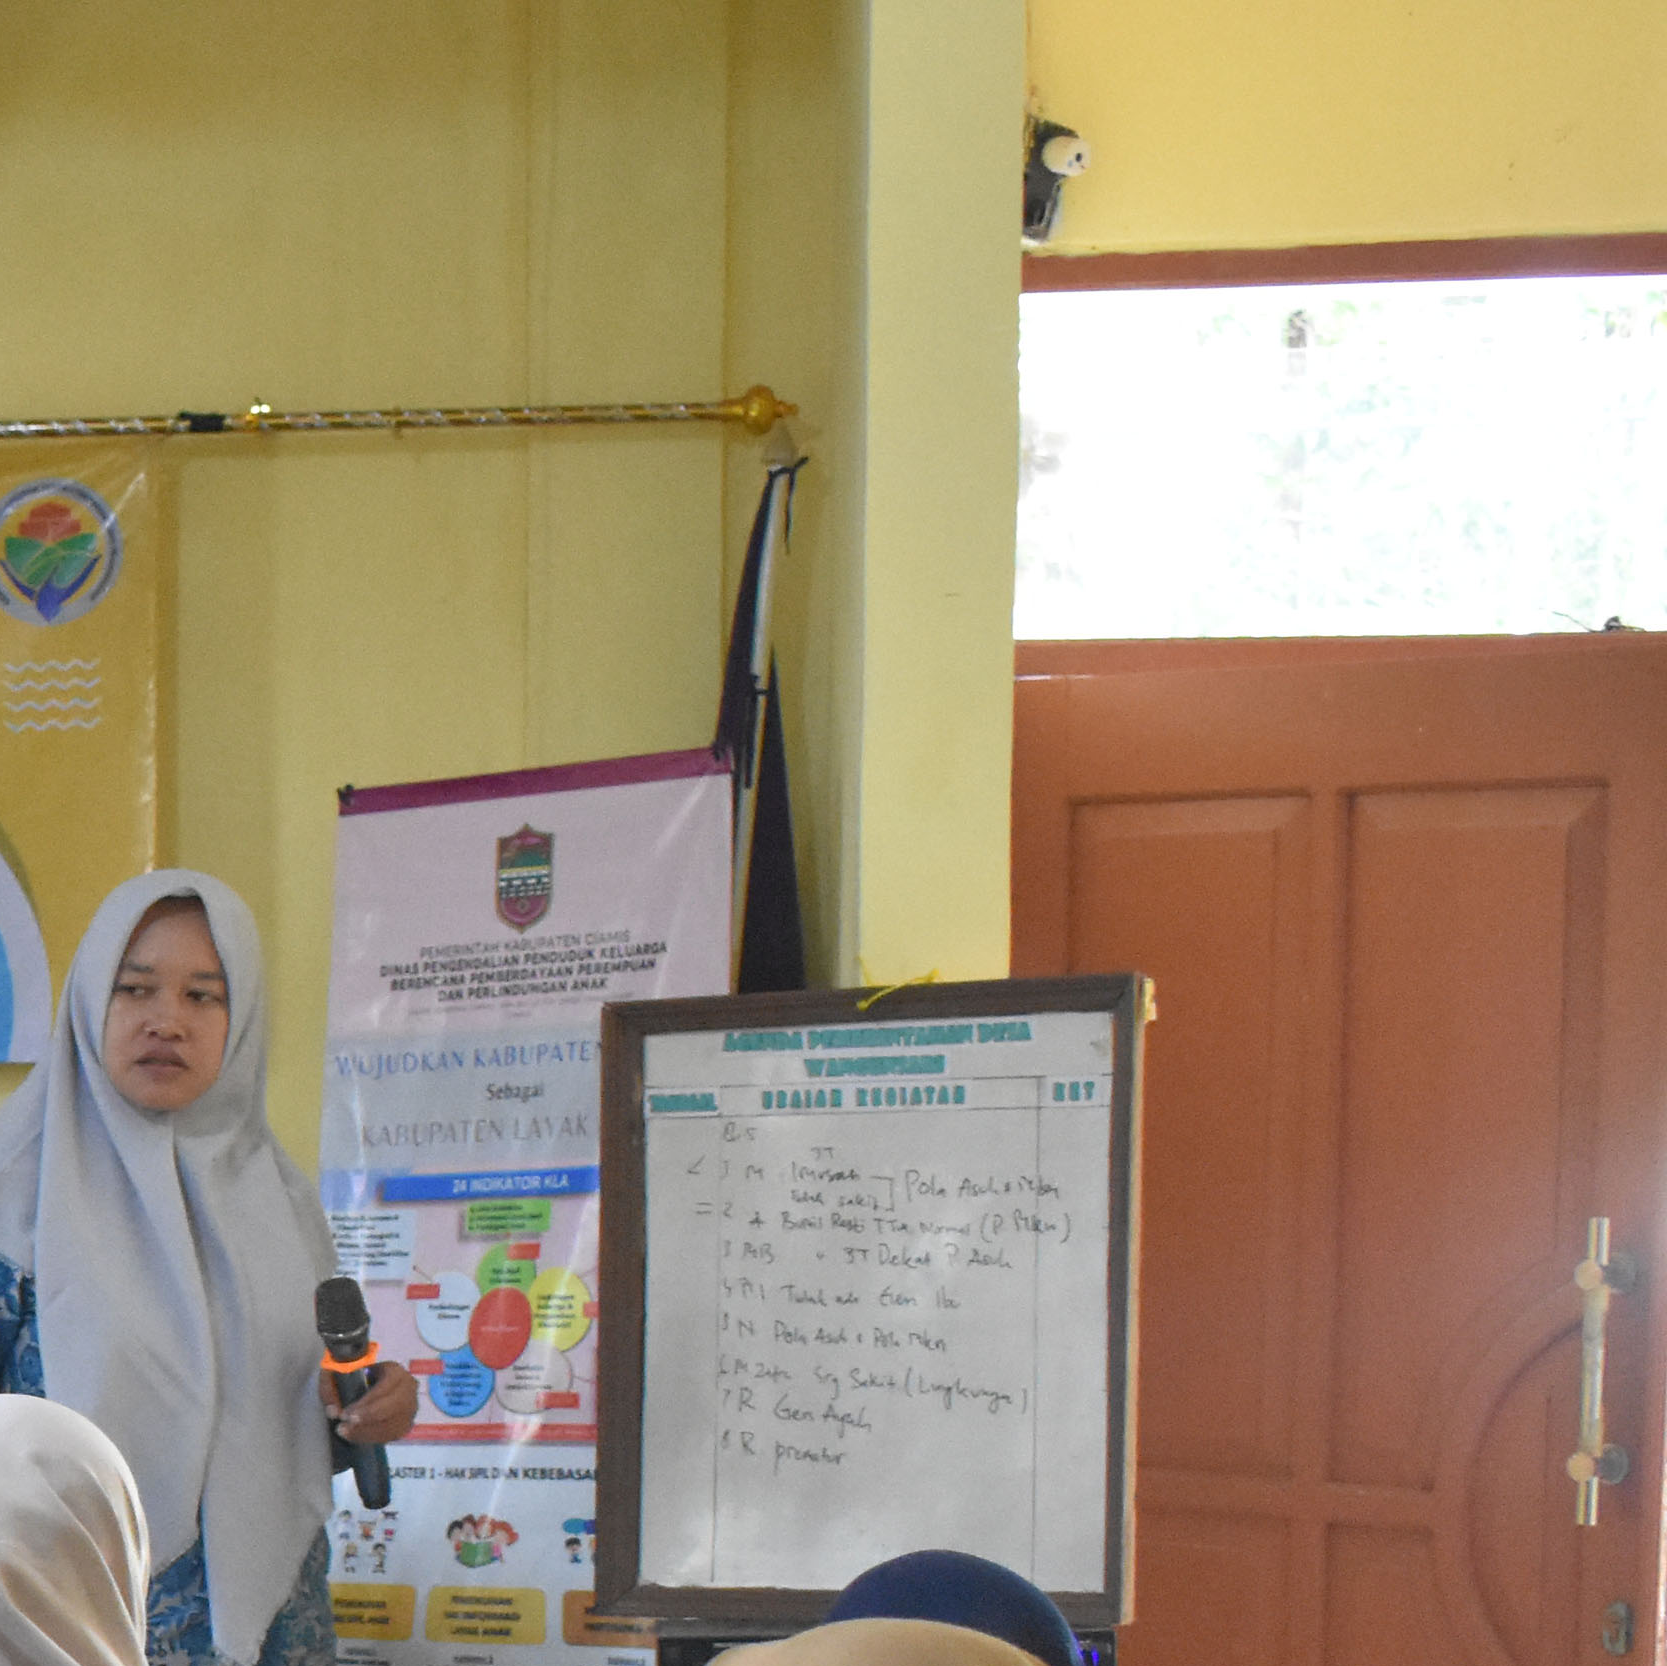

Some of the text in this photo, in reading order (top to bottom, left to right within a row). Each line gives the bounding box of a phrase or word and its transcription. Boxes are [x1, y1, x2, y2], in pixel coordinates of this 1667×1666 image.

[379, 941, 667, 978] DINAS PENGENDALIAN PENDUDUK KELUARGA
[419, 929, 631, 960] PEMERINTAH KABUPATEN CIAMIS
[390, 958, 657, 992] BERENCANA PEMBERDAYAAN PEREMPUAN
[438, 977, 608, 1002] DAN PERLINDUNGAN ANAK
[335, 1050, 465, 1080] WUJUDKAN
[486, 1081, 545, 1103] Sebagai
[361, 1112, 588, 1148] KABUPATEN LAYAK
[469, 1176, 542, 1193] INDIKATOR
[544, 1174, 570, 1189] KLA
[522, 1467, 596, 1481] KEBEBASA
